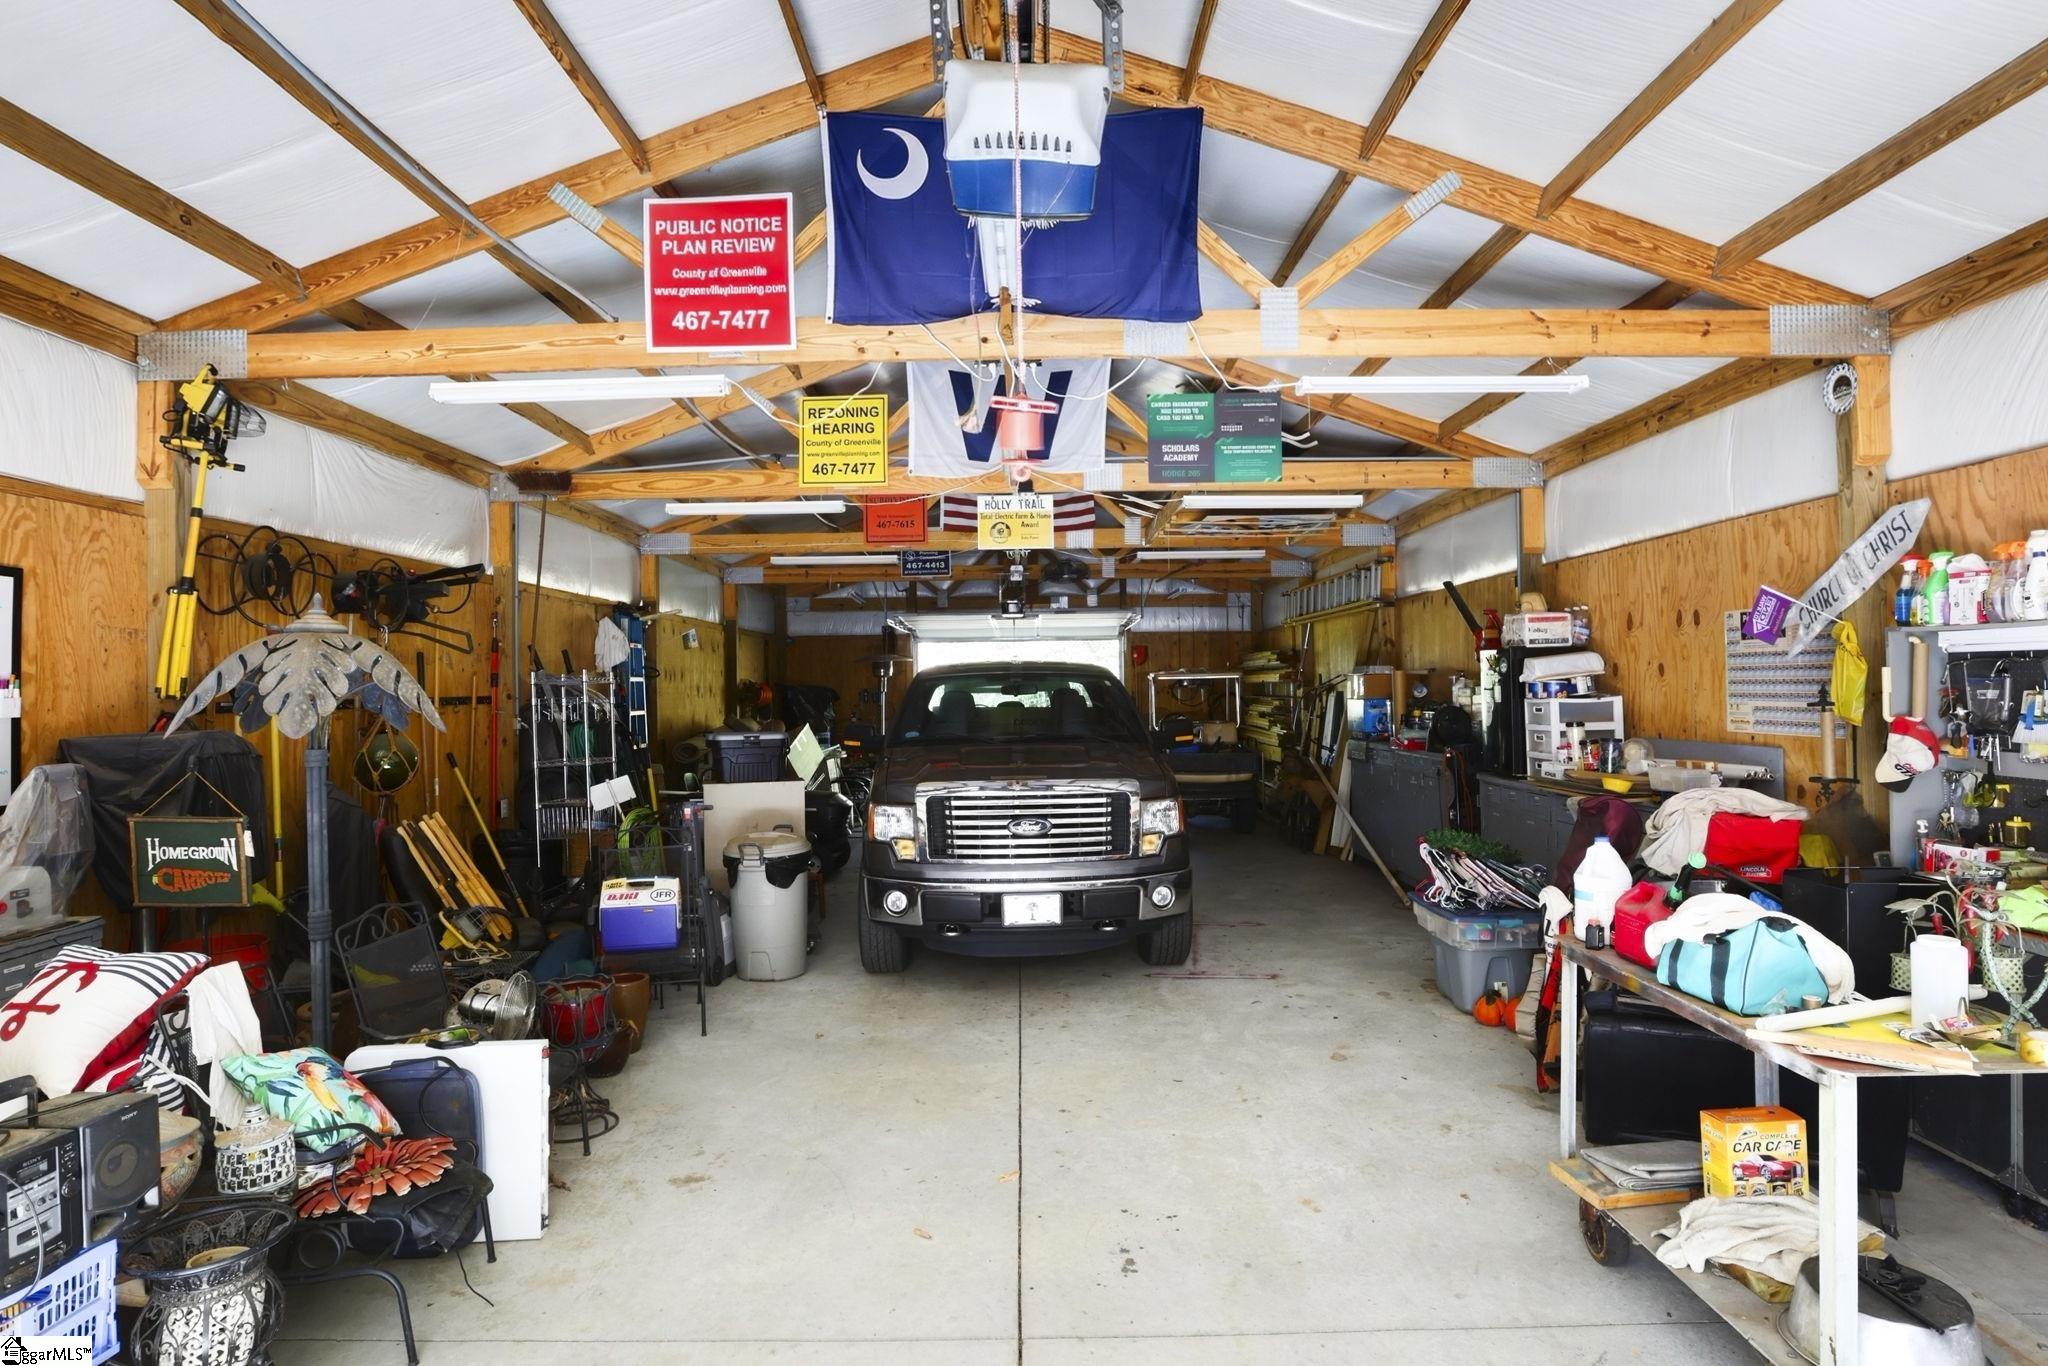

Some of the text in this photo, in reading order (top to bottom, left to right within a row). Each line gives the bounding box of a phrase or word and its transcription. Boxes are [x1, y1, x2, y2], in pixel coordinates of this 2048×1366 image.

[655, 216, 783, 235] PUBLIC NOTICE
[661, 237, 776, 255] PLAN REVIEW
[672, 265, 768, 280] County of Greenville
[654, 284, 787, 298] www.greenvilleplanning.com
[671, 308, 770, 331] 467-7477
[808, 406, 880, 419] REZONING
[812, 422, 875, 435] HEARING
[806, 439, 833, 447] County
[844, 438, 882, 446] Greenville
[1161, 444, 1200, 453] SCHOLARS
[1163, 454, 1198, 462] ACADEMY
[812, 462, 876, 475] 467-7477
[984, 498, 1046, 510] HOLLY TRAIL
[980, 512, 993, 520] Total
[995, 512, 1014, 520] Electric
[876, 519, 915, 529] 467-7615
[1862, 510, 1913, 571] CHRIST
[145, 837, 239, 872] HOMEGROWN
[654, 890, 672, 899] JFR
[121, 1110, 138, 1121] SONY
[1733, 1141, 1762, 1153] CAR
[22, 1156, 42, 1168] SONY
